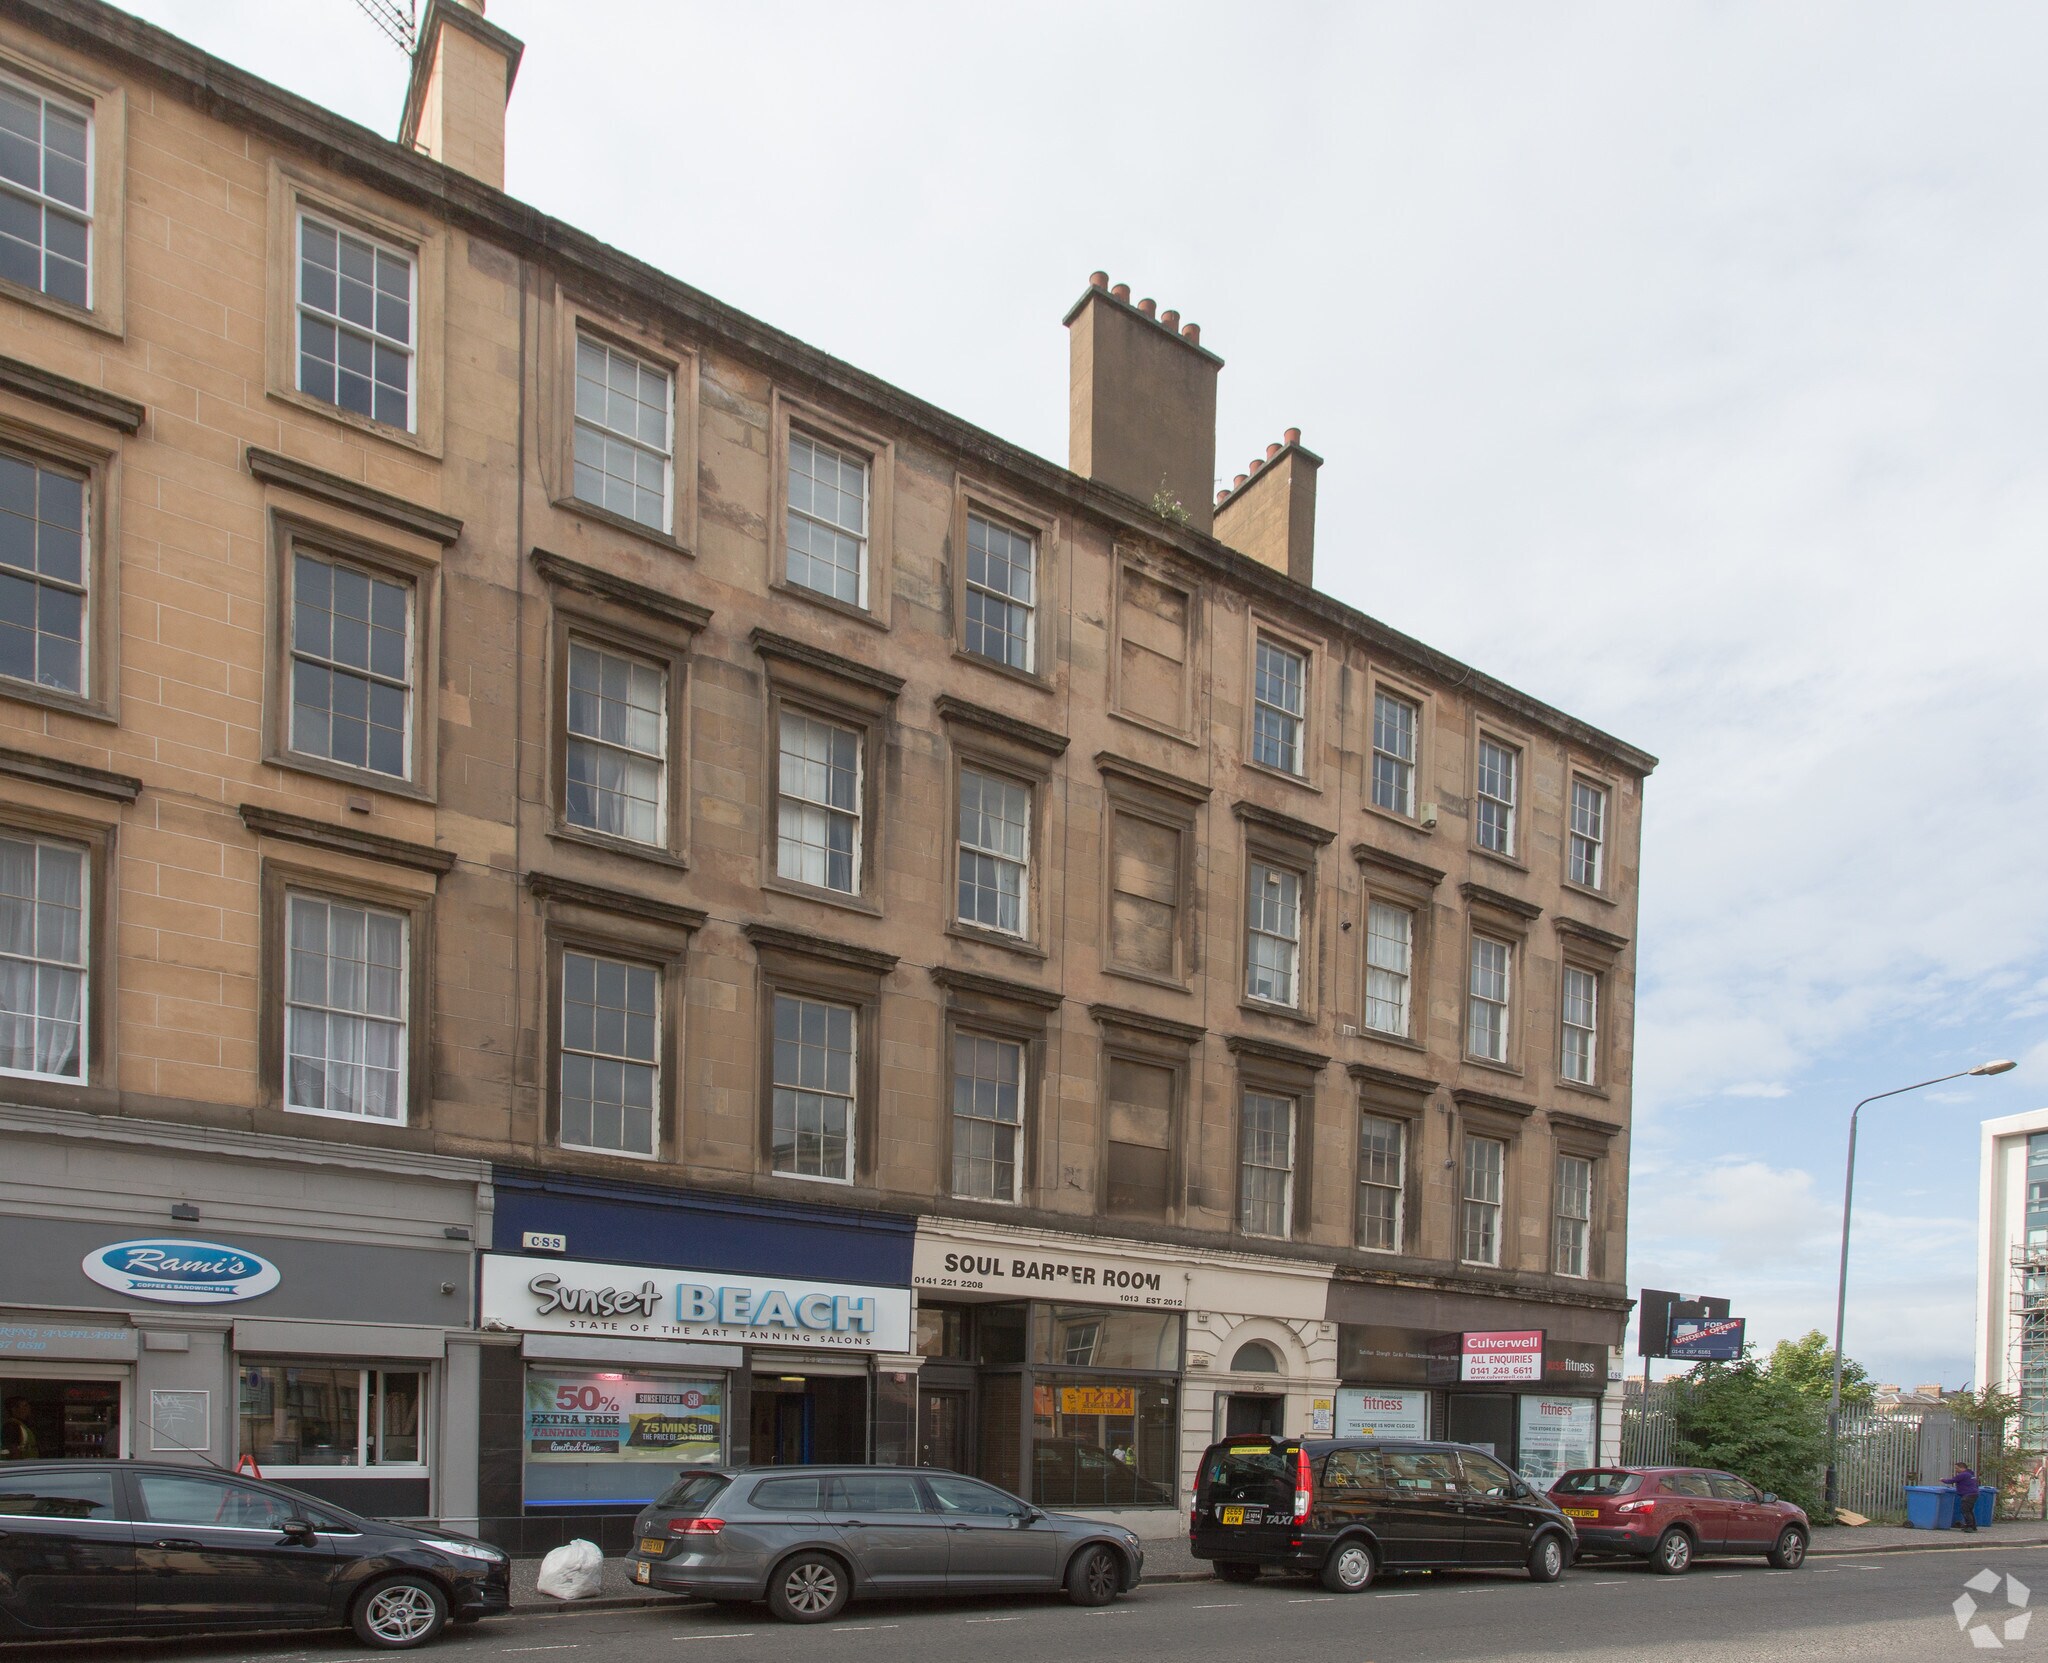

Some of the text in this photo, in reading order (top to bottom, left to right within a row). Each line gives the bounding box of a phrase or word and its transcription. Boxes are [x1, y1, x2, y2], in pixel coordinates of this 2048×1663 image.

[125, 1248, 248, 1275] Rami's
[944, 1253, 1005, 1277] SOUL
[1102, 1269, 1161, 1291] ROOM
[136, 1282, 165, 1290] COFFEE
[173, 1283, 215, 1292] SANDWICH
[914, 1276, 984, 1289] 0141 221 2208
[528, 1272, 876, 1333] Sunset BEACH
[1119, 1294, 1183, 1307] 1013 EST 2012
[569, 1320, 872, 1346] STATE OF THE ART TANNING SALONS
[1675, 1321, 1738, 1344] UNDER OFFER
[16, 1341, 47, 1351] 0510
[1467, 1336, 1538, 1348] Culverwell
[1470, 1355, 1533, 1365] ALL ENQUIRIES
[1470, 1366, 1533, 1375] 0141 248 6611
[555, 1385, 620, 1412] 50%
[639, 1394, 681, 1404] SUNSETBEACH
[687, 1393, 699, 1406] SB
[1363, 1396, 1403, 1411] fitness
[1540, 1402, 1573, 1416] fitness
[531, 1414, 620, 1425] EXTRA FREE
[532, 1428, 620, 1438] TANNING MINS
[642, 1422, 714, 1434] 75 MINS FOR
[550, 1441, 601, 1452] limited time
[1226, 1507, 1243, 1515] SE65
[1266, 1515, 1294, 1525] TAXI
